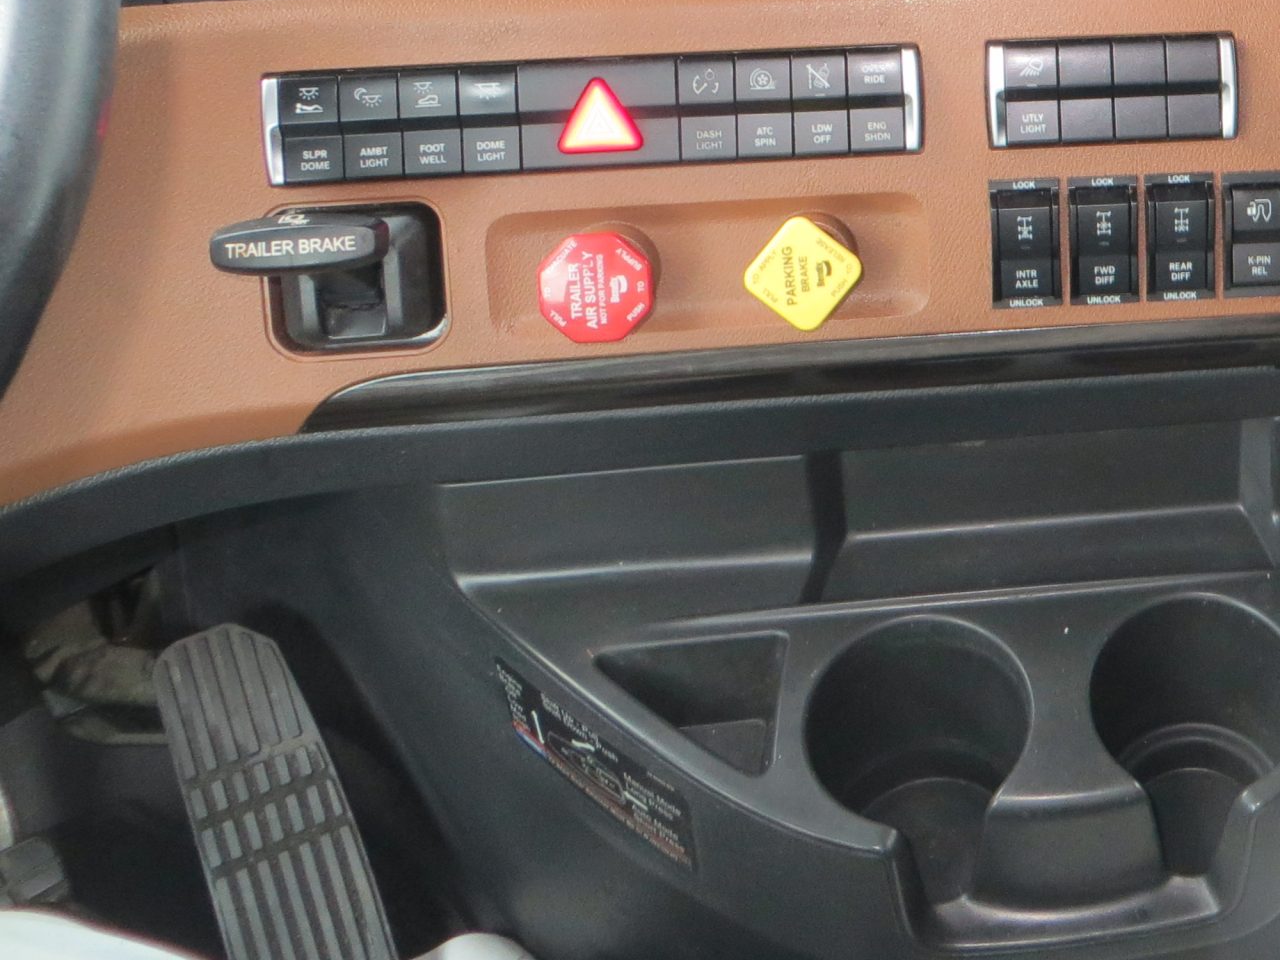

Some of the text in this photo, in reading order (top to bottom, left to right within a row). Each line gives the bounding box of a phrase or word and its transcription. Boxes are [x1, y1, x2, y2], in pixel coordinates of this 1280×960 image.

[863, 74, 886, 85] RIDE
[1021, 113, 1044, 124] UTLY
[755, 126, 773, 137] ATC
[867, 121, 888, 131] ENG
[1019, 124, 1047, 135] LIGHT
[696, 129, 723, 140] DASH
[813, 134, 832, 145] OFF
[864, 131, 891, 142] SHDN
[476, 139, 506, 151] DOME
[695, 140, 724, 151] LIGHT
[754, 137, 776, 147] SPIN
[359, 146, 388, 157] AMBT
[419, 143, 446, 154] FOOT
[302, 149, 328, 161] SLPR
[419, 153, 447, 165] WELL
[477, 151, 506, 162] LIGHT
[301, 160, 331, 171] DOME
[359, 156, 389, 168] LIGHT
[1091, 178, 1114, 187] LOCK
[1168, 175, 1190, 184] LOCK
[1012, 181, 1036, 190] LOCK
[224, 235, 357, 259] TRAILER BRAKE
[1094, 265, 1116, 275] FWD
[1169, 261, 1193, 271] REAR
[1252, 265, 1268, 276] REL
[781, 245, 798, 307] PARKING
[798, 255, 811, 293] BRAKE
[1015, 269, 1037, 279] INTR
[1171, 271, 1191, 281] DIFF
[1015, 279, 1039, 289] AXLE
[1095, 275, 1115, 285] DIFF
[567, 262, 583, 320] TRAILER
[581, 250, 599, 329] AIR SUPPLY
[1086, 295, 1121, 304] UNLOCK
[1163, 291, 1197, 300] UNLOCK
[1009, 298, 1044, 307] UNLOCK
